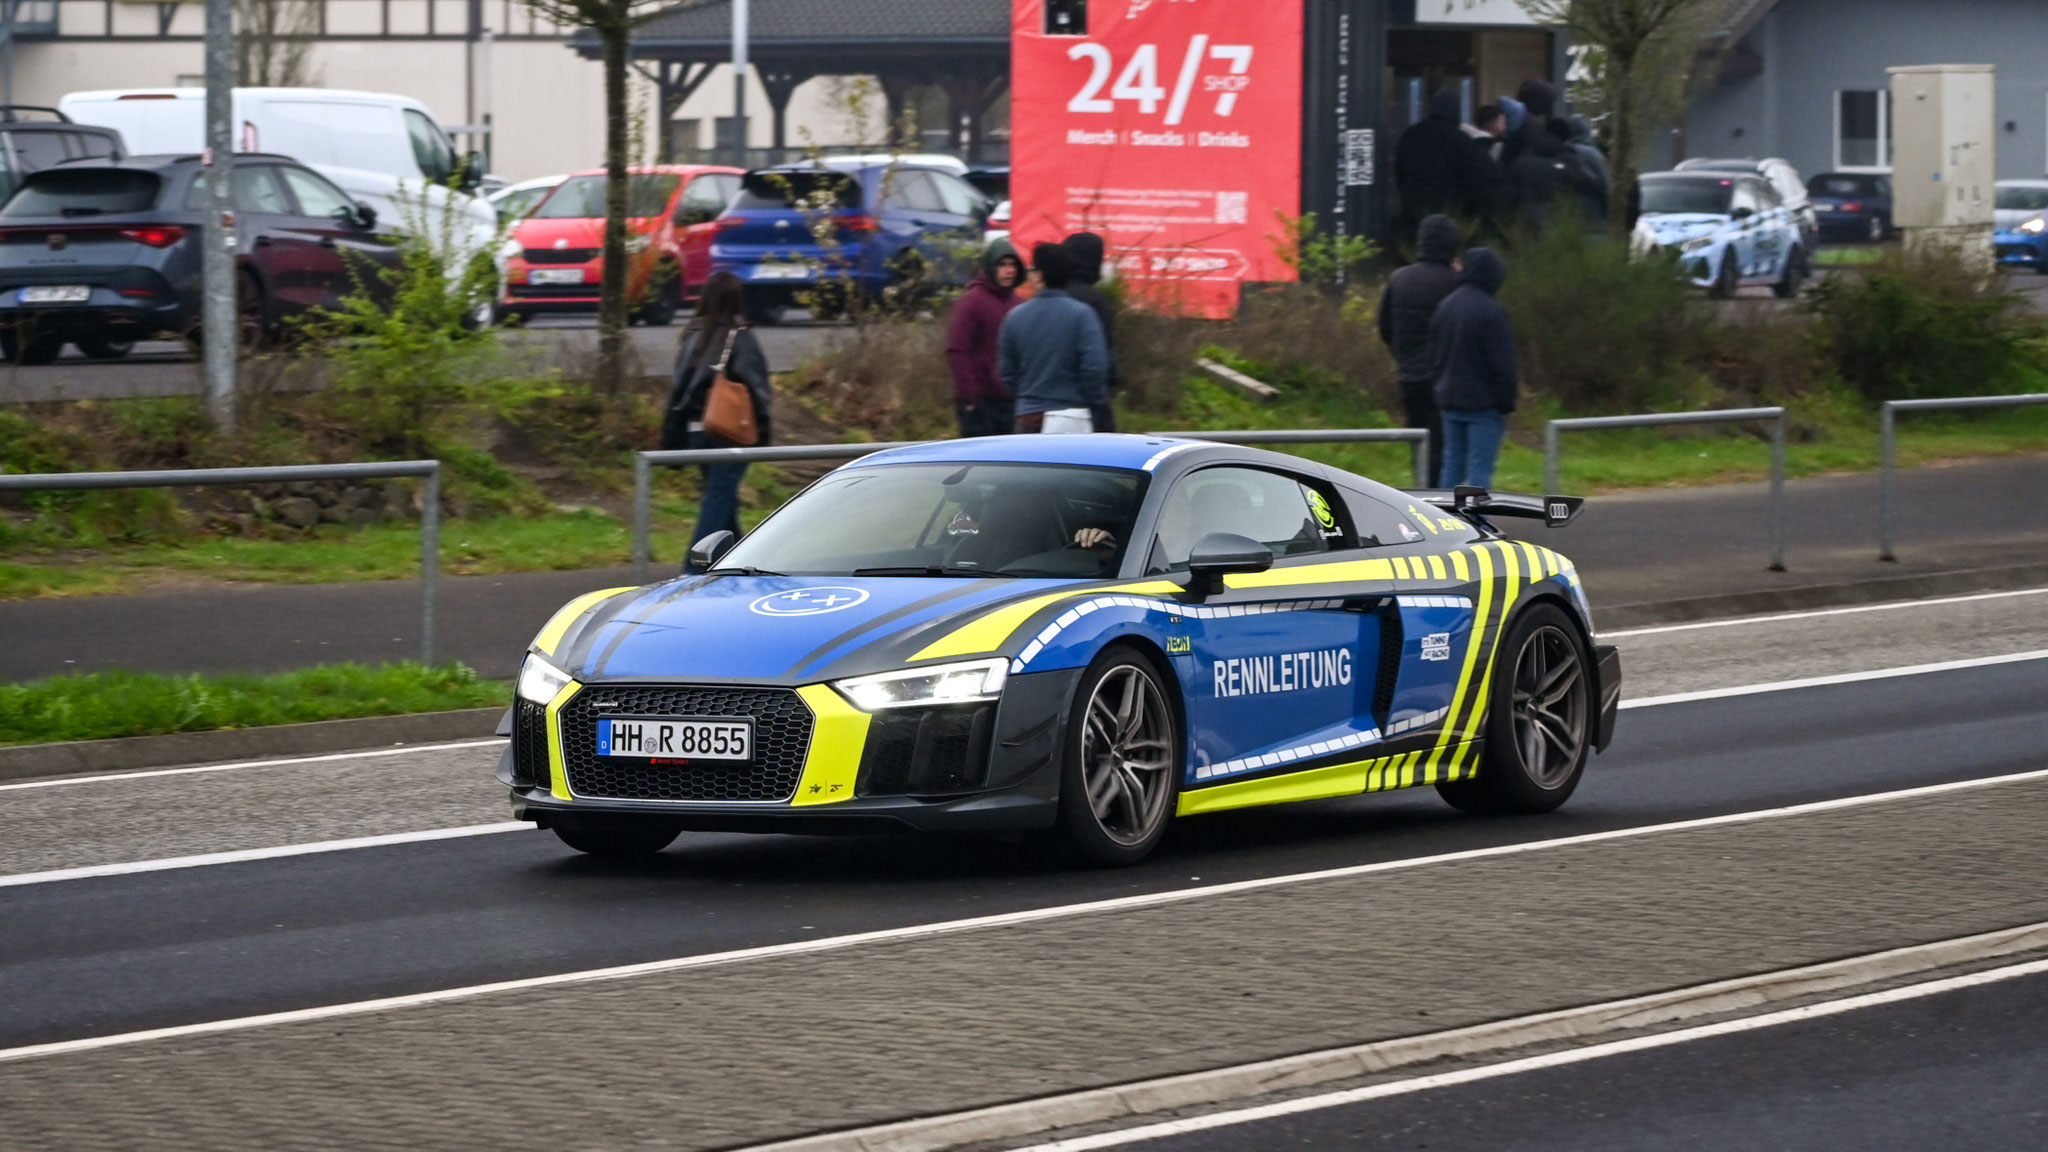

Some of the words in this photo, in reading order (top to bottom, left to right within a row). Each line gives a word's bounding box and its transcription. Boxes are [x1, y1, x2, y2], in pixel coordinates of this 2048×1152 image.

[1066, 33, 1254, 126] 24/7
[1203, 75, 1250, 91] SHOP
[1066, 129, 1118, 145] Merch
[1131, 130, 1185, 147] Snacks
[1198, 131, 1250, 148] Drinks
[1213, 648, 1351, 698] RENNLEITUNG
[601, 741, 608, 749] D
[612, 723, 643, 751] HH
[659, 725, 674, 753] R
[682, 726, 746, 755] 8855
